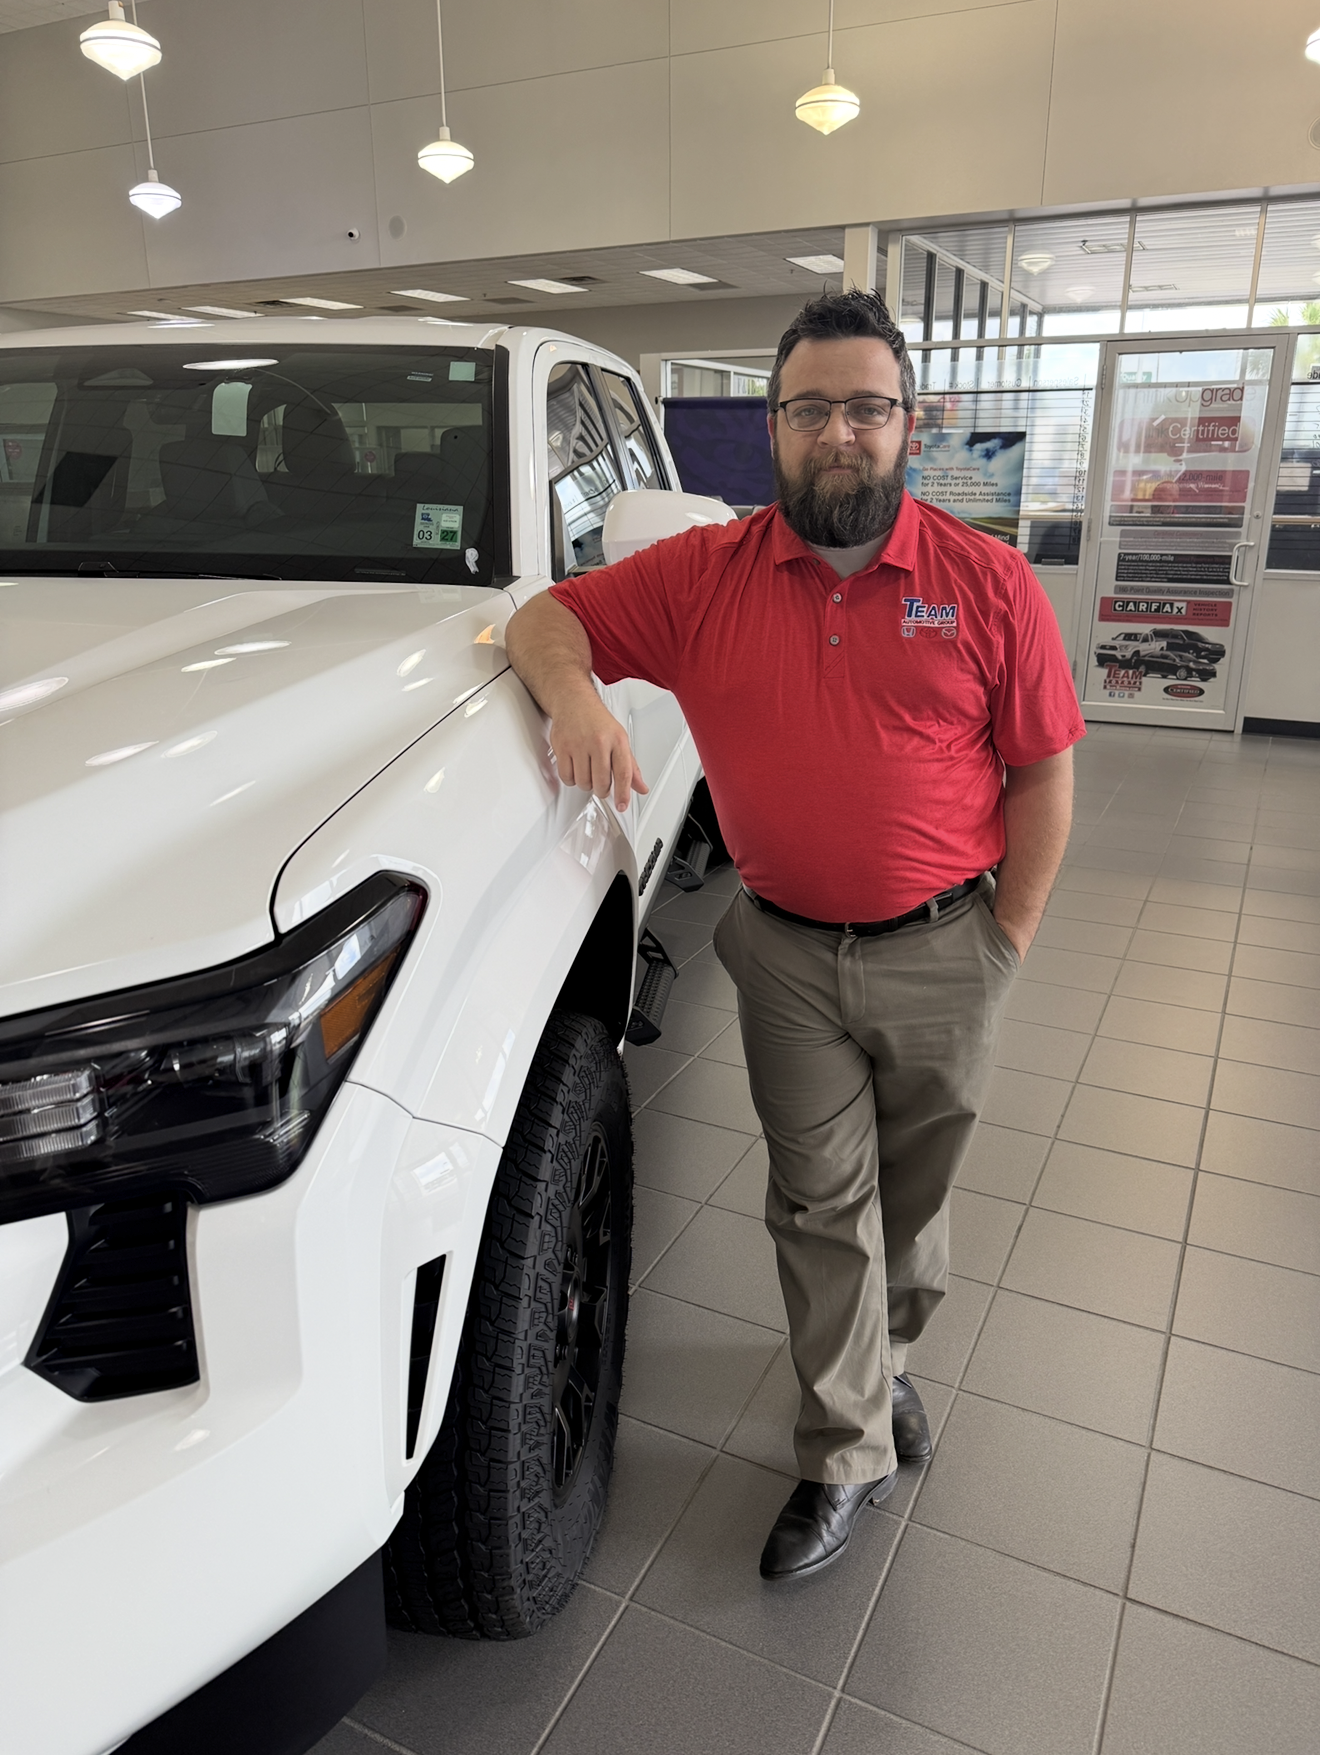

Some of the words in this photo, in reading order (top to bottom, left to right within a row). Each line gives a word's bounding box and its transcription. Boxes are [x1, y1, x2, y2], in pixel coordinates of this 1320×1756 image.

[1168, 422, 1240, 440] Certified
[417, 529, 433, 541] 03
[441, 530, 458, 541] 27
[1120, 553, 1174, 561] 7-year/100,000-mile
[1130, 585, 1145, 593] Point
[1146, 586, 1166, 595] Quality
[1166, 587, 1197, 595] Assurance
[1199, 588, 1230, 597] Inspection
[902, 597, 957, 619] TEAM
[1114, 601, 1185, 615] CARFAX
